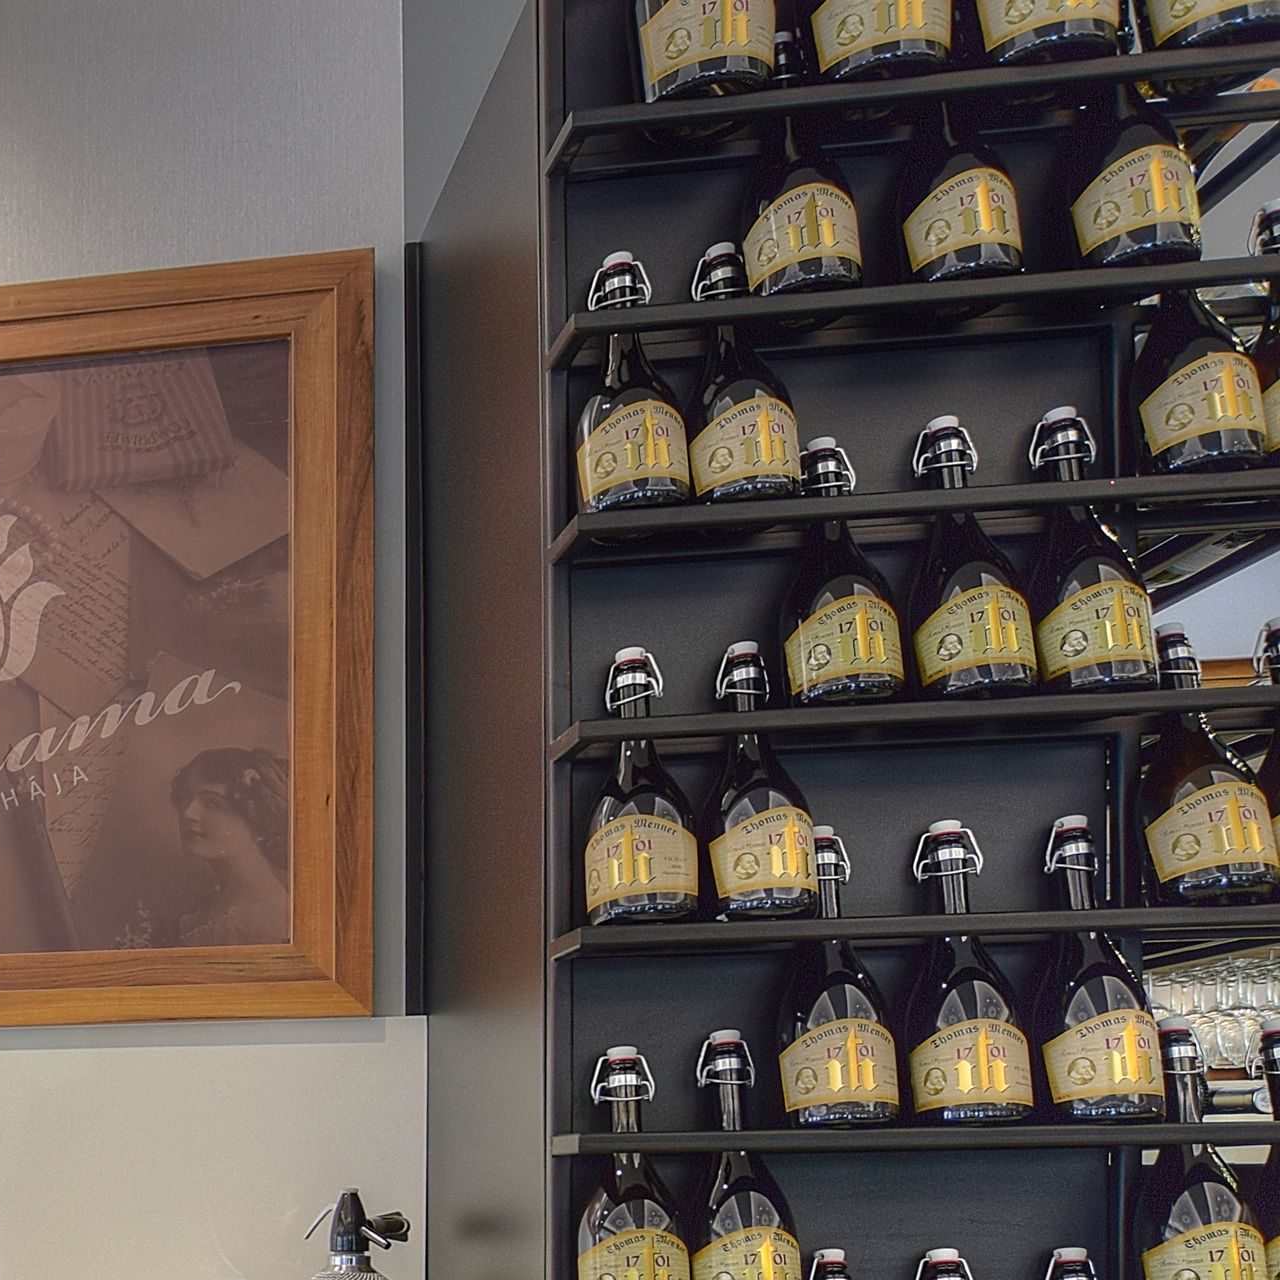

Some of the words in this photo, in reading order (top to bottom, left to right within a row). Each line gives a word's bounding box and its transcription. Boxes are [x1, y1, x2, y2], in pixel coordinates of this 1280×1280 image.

[1101, 153, 1151, 183] Thomas
[1172, 358, 1224, 385] Thomas
[602, 407, 646, 435] Thomas
[716, 403, 762, 429] Thomas
[948, 590, 990, 615] Thomas
[1071, 586, 1114, 611] Thomas
[817, 600, 858, 625] Thomas
[1178, 789, 1229, 815] Thomas
[633, 819, 677, 836] Menner
[741, 814, 788, 835] Thomas
[802, 1024, 849, 1048] Thomas
[857, 1023, 891, 1045] Menner
[931, 1024, 979, 1049] Thomas
[988, 1023, 1024, 1045] Menner
[1077, 1015, 1127, 1038] Thomas
[606, 1234, 646, 1254] Thomas
[1185, 1229, 1229, 1248] Thomas
